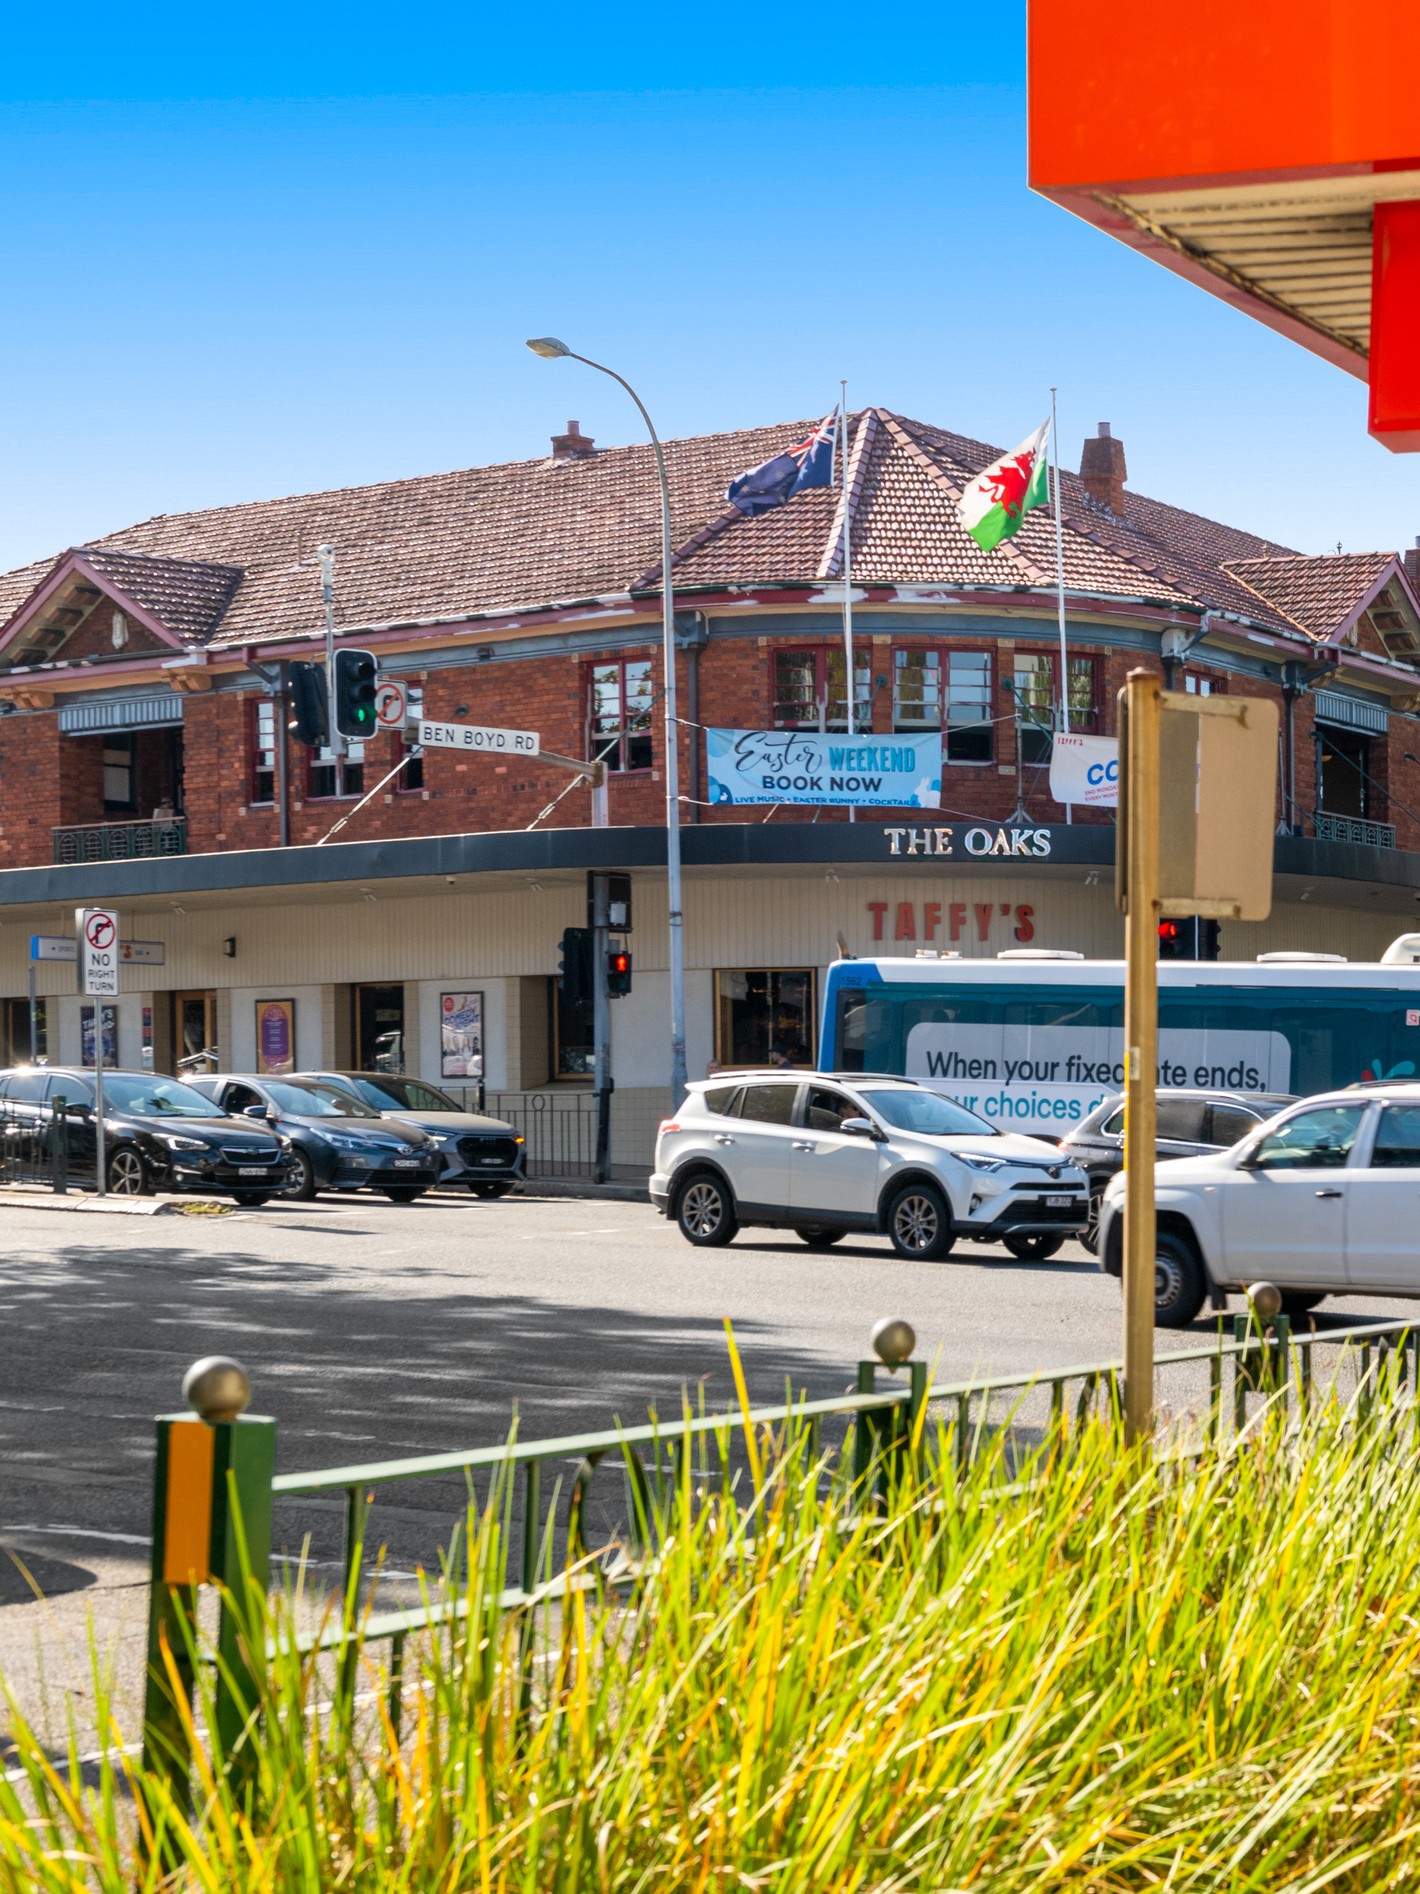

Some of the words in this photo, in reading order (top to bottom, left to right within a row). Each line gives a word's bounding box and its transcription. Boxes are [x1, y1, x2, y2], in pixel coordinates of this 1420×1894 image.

[423, 726, 455, 743] BEN
[464, 730, 505, 748] BOYD
[515, 735, 535, 750] RD
[735, 731, 822, 773] Easter
[829, 746, 916, 772] WEEKEND
[762, 775, 823, 791] BOOK
[830, 776, 882, 792] NOW
[757, 795, 784, 803] MUSIC
[793, 796, 828, 804] EASTER
[829, 797, 860, 805] BUNNY
[869, 798, 916, 806] COCKTAILS
[884, 827, 953, 855] THE
[964, 827, 1051, 857] OAKS
[868, 902, 1035, 942] TAFFY'S
[91, 953, 111, 967] NO
[88, 969, 115, 979] RIGHT
[89, 981, 114, 991] TURN
[926, 1051, 998, 1079] When
[1004, 1055, 1060, 1086] your
[1194, 1060, 1266, 1092] ends,
[983, 1090, 1081, 1120] choices
